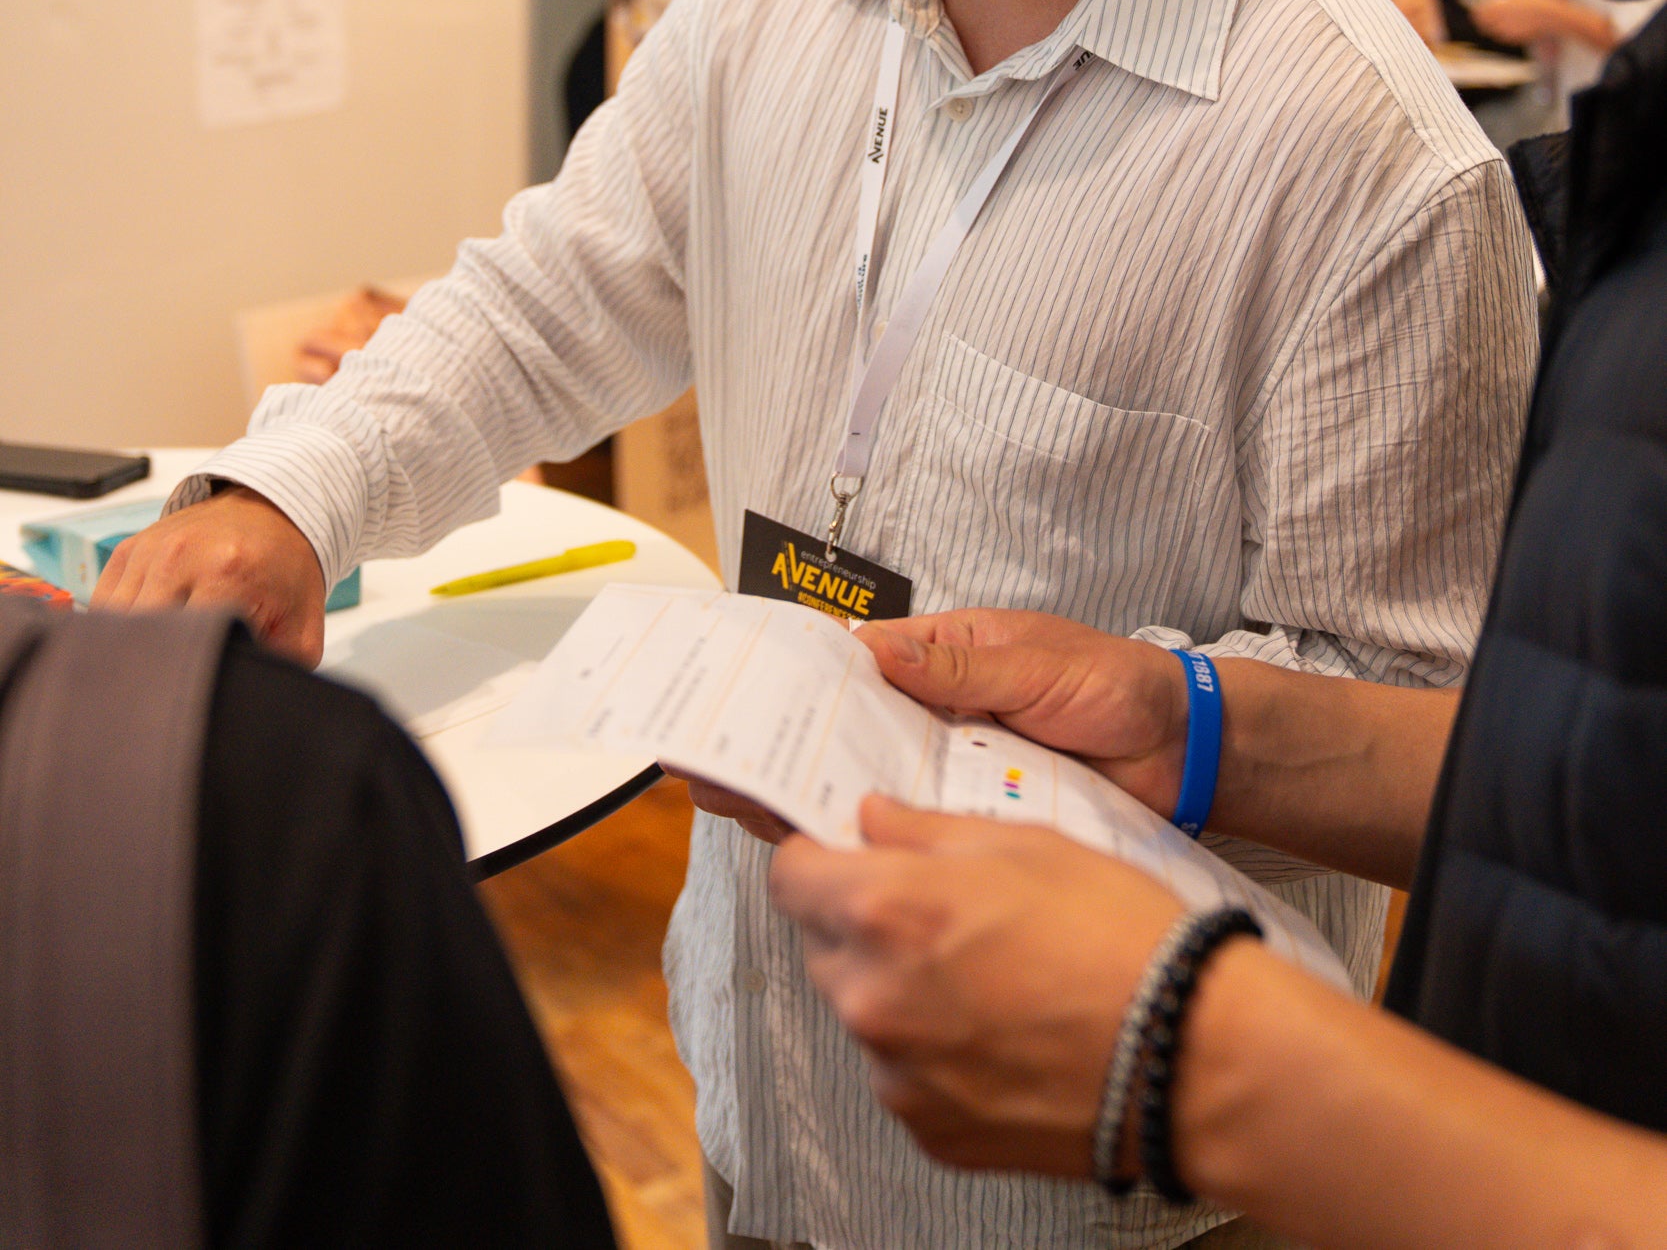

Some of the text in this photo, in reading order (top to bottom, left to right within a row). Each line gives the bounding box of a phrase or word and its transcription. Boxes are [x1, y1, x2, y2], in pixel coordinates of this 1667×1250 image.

[868, 107, 888, 164] AVENUE
[771, 542, 875, 615] AVENUE
[800, 551, 875, 590] entrepreneurship
